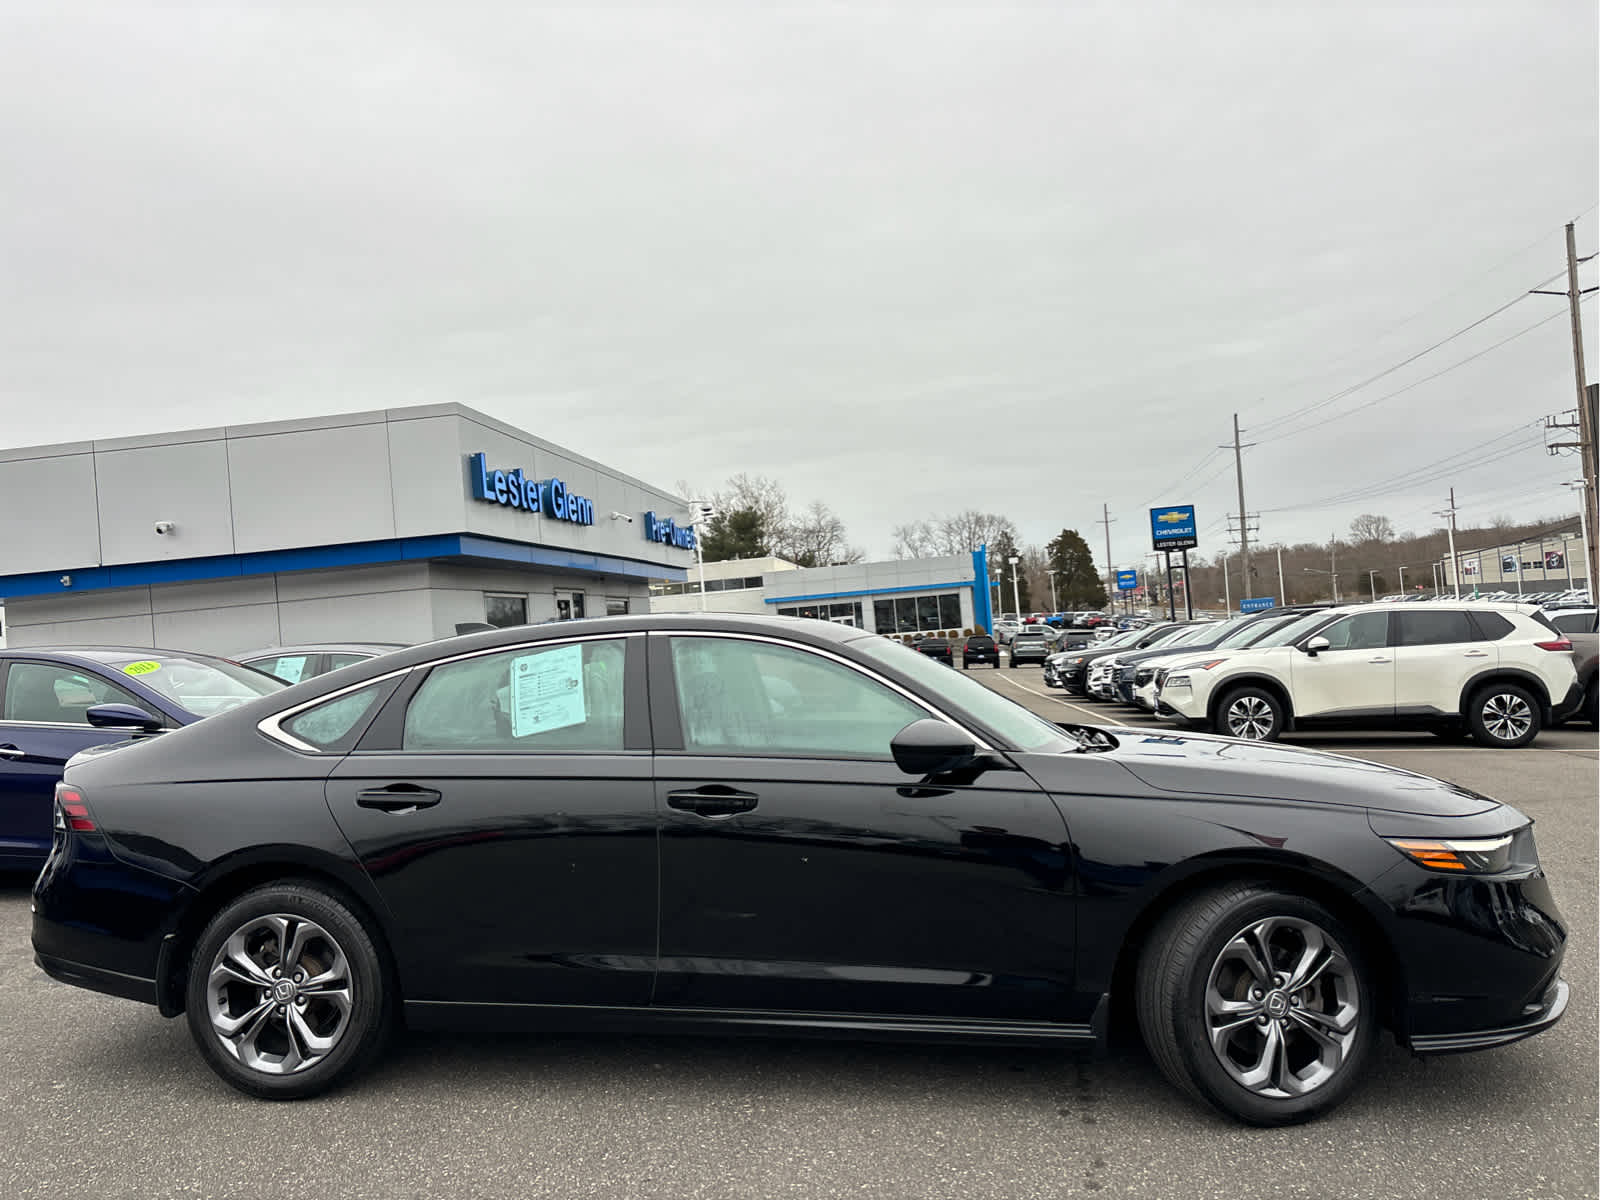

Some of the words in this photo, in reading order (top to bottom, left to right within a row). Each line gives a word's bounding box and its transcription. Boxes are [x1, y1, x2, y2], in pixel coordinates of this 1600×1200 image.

[471, 452, 544, 513] Lester
[548, 477, 595, 526] Glenn
[1156, 527, 1192, 536] CHEVROLET
